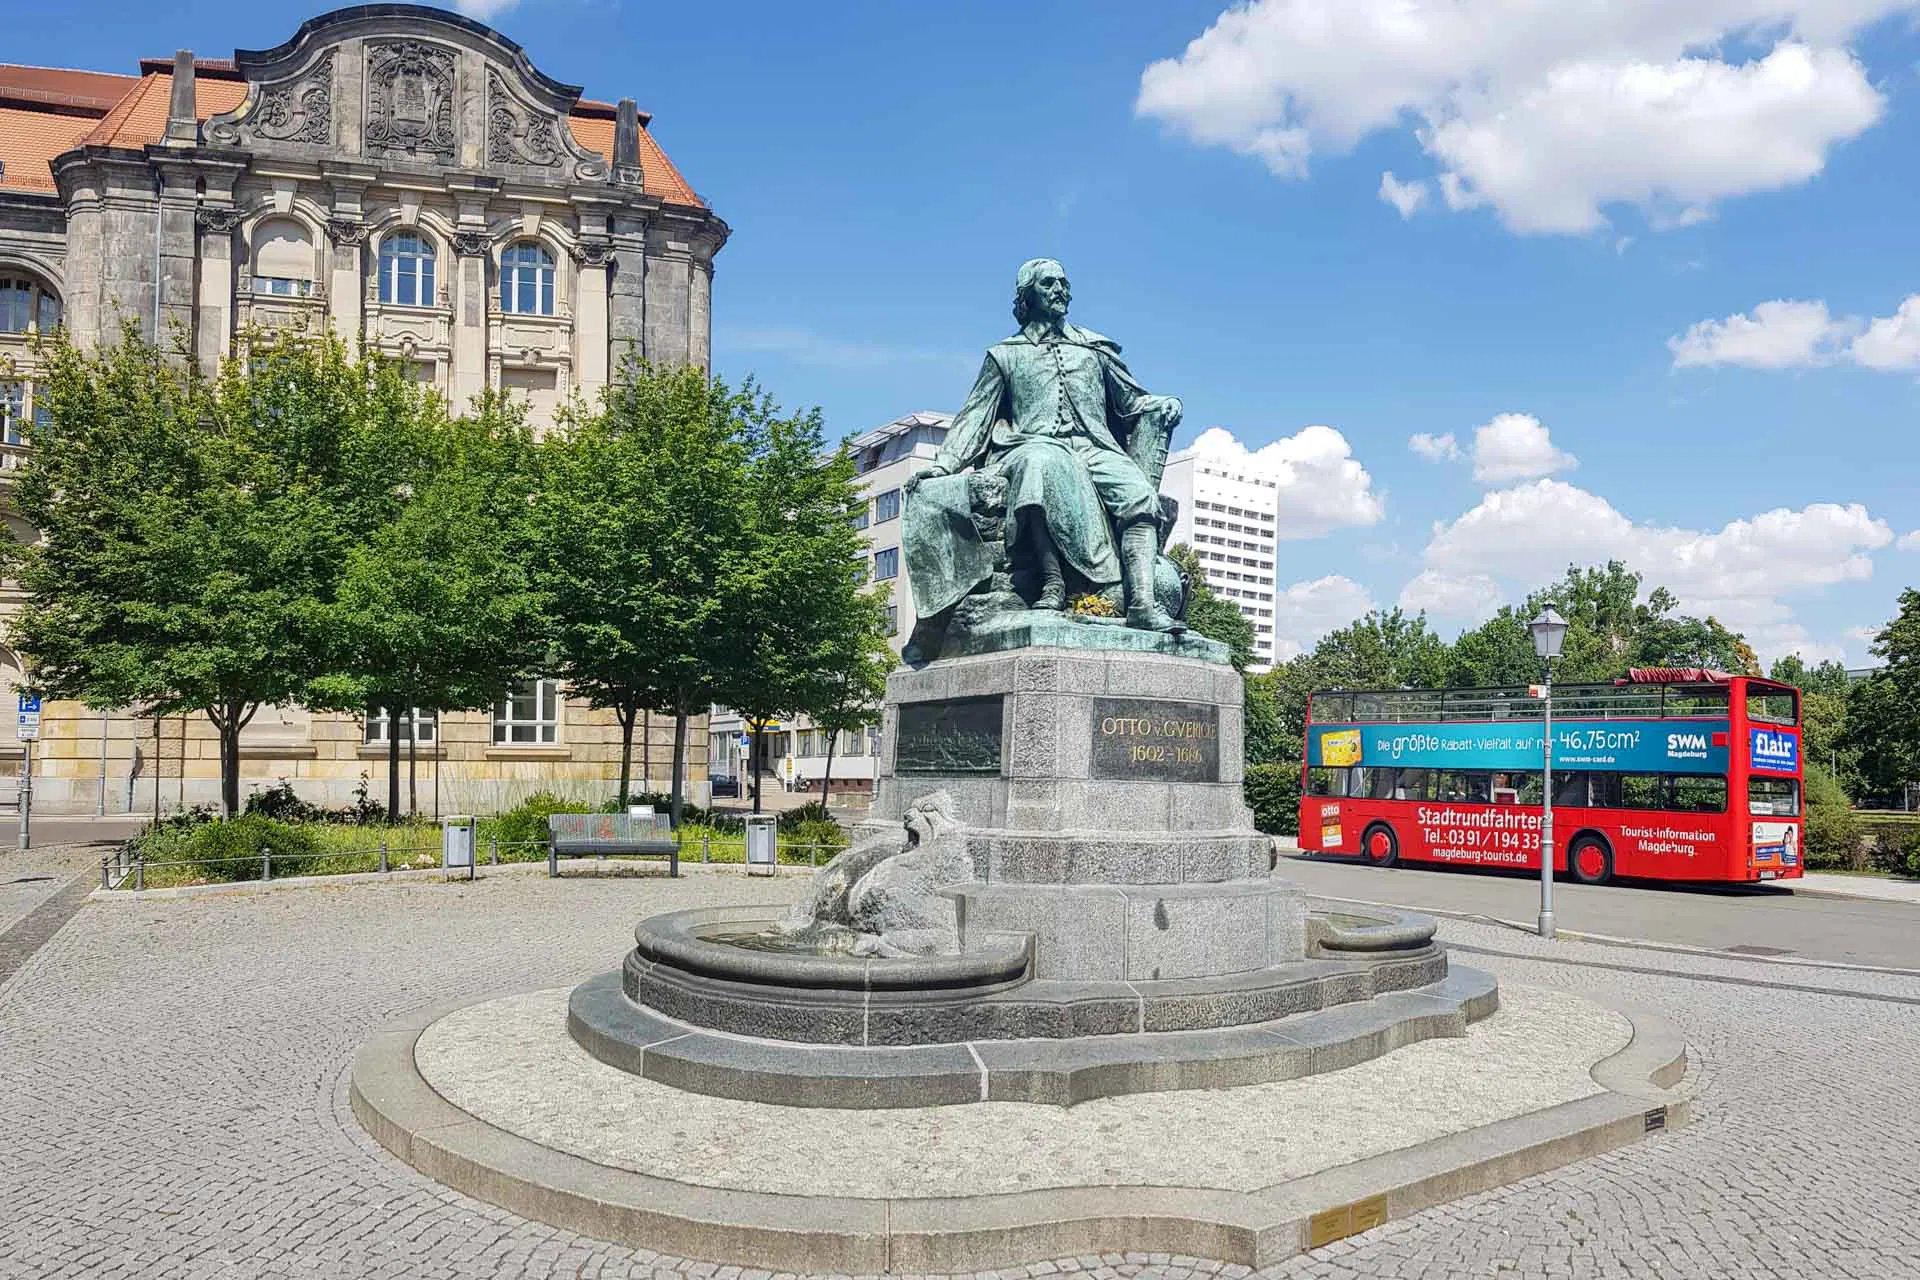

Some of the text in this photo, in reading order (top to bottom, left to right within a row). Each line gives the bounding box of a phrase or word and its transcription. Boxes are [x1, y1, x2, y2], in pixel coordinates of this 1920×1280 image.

[1102, 717, 1151, 735] OTTO
[1377, 740, 1390, 751] Die
[1391, 734, 1439, 759] größte
[1441, 737, 1512, 751] Rabatt-Vielfalt
[1515, 737, 1534, 750] auf
[1536, 738, 1556, 750] nr
[1667, 734, 1707, 750] SWM
[1756, 733, 1792, 757] flair
[1132, 745, 1165, 763] 1602
[1667, 750, 1708, 759] Magdeburg
[1321, 805, 1340, 817] otto
[1620, 825, 1715, 841] Tourist-Information
[1432, 847, 1528, 863] magdeburg-tourist.de
[1638, 839, 1694, 857] Magdeburg
